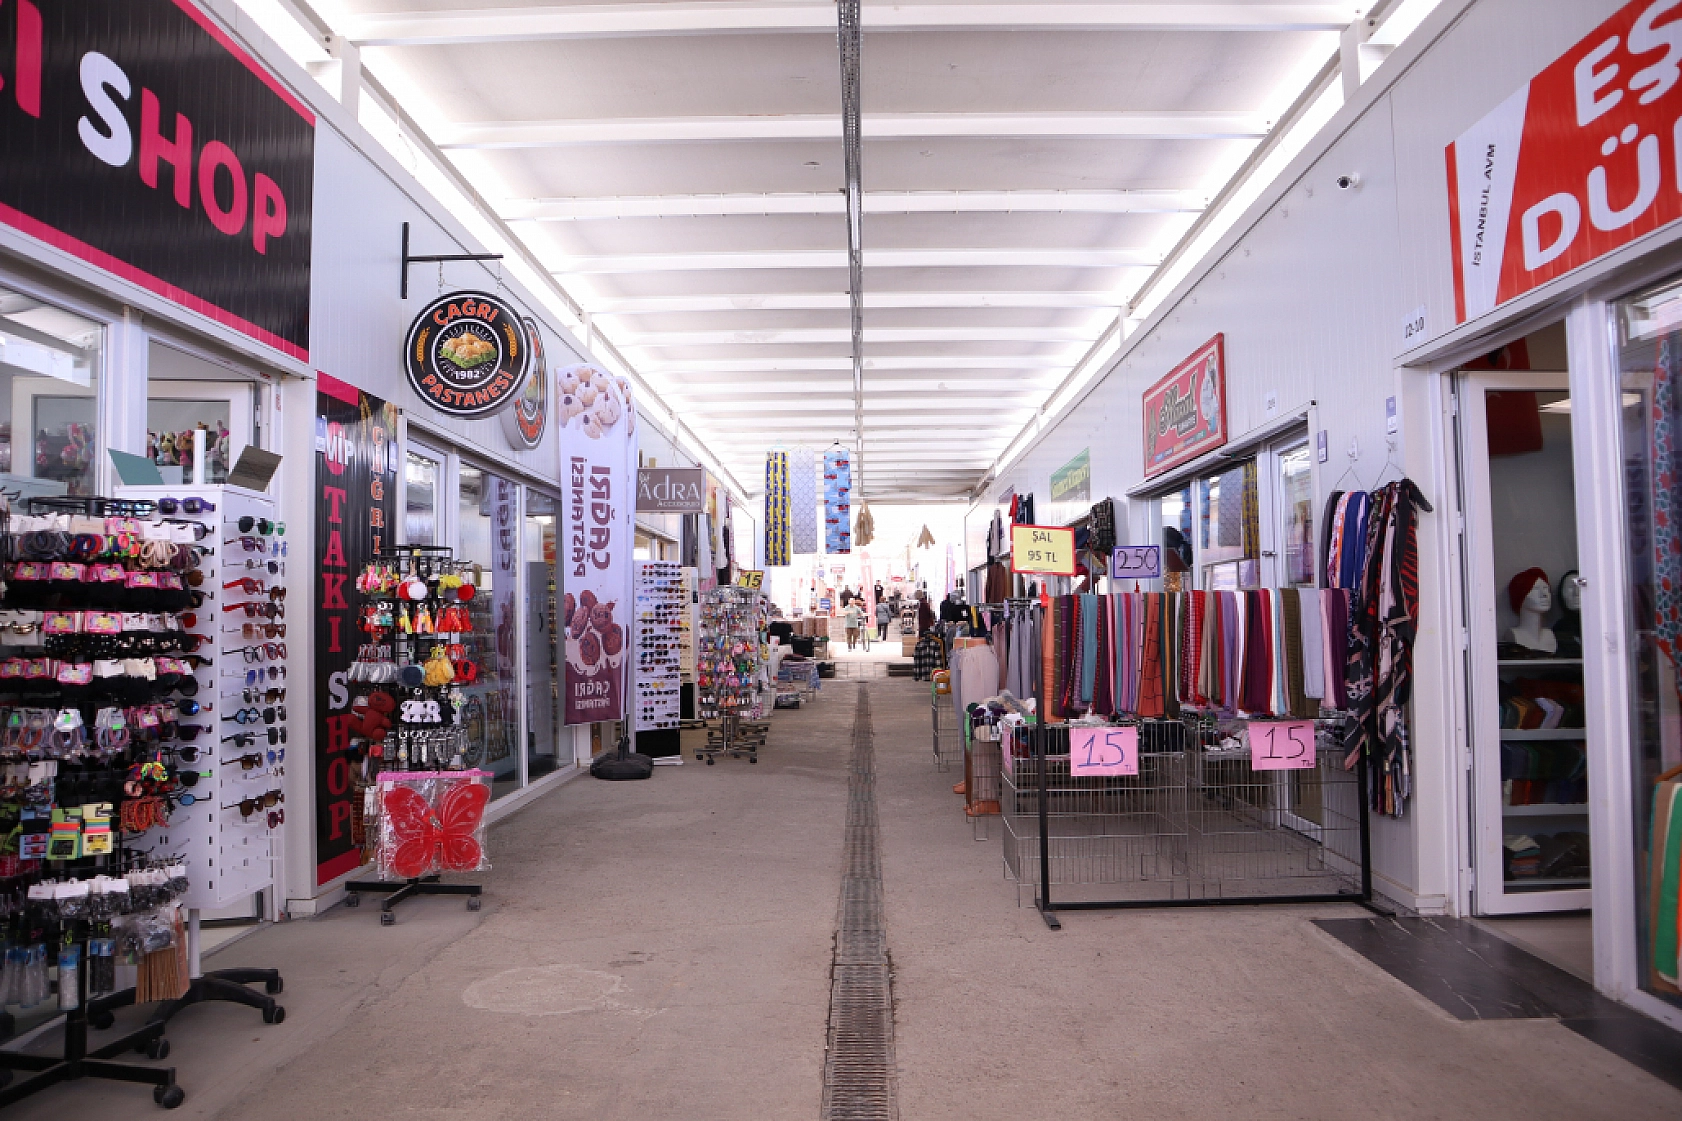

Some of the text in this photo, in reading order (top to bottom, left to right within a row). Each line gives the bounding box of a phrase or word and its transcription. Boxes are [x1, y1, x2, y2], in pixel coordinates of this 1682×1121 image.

[77, 51, 287, 255] SHOP
[1484, 144, 1496, 180] AVM
[1521, 115, 1682, 272] DÜ
[321, 485, 349, 653] TAKI
[745, 572, 761, 587] 15
[1027, 550, 1059, 563] 95 TL
[326, 671, 350, 841] SHOP
[1260, 725, 1306, 759] 15
